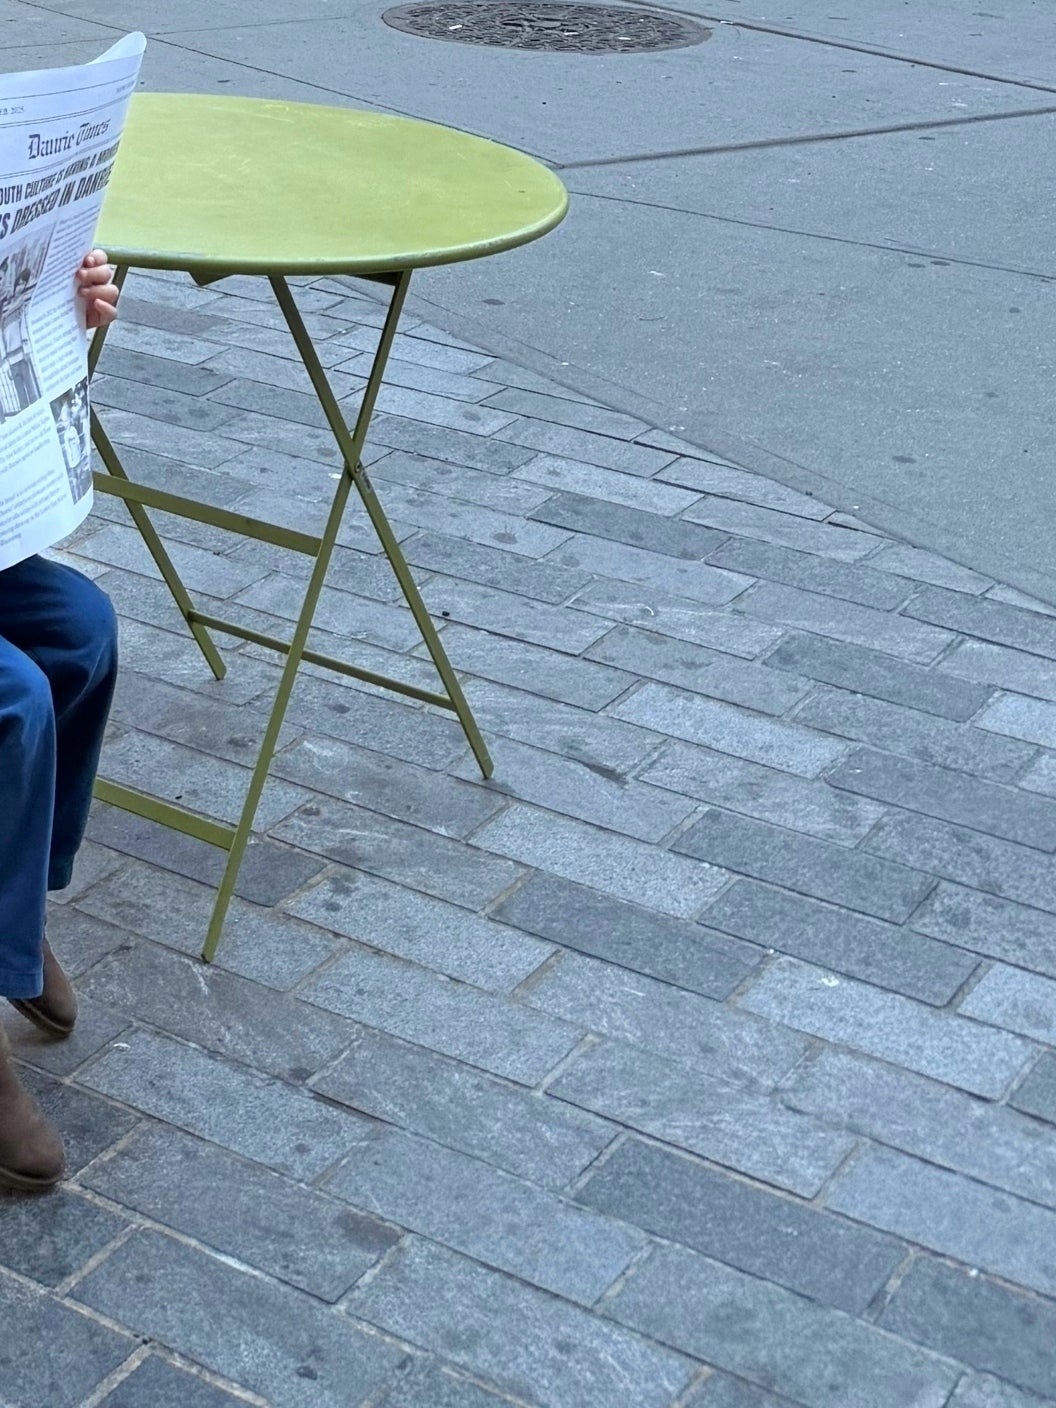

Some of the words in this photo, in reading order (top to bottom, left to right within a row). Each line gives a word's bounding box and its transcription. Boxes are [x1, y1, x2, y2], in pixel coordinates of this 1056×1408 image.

[76, 118, 111, 146] Times
[24, 173, 57, 199] CULTURE
[55, 167, 65, 185] IS
[89, 153, 98, 169] A
[10, 188, 61, 235] DRESSED
[58, 180, 76, 208] IN
